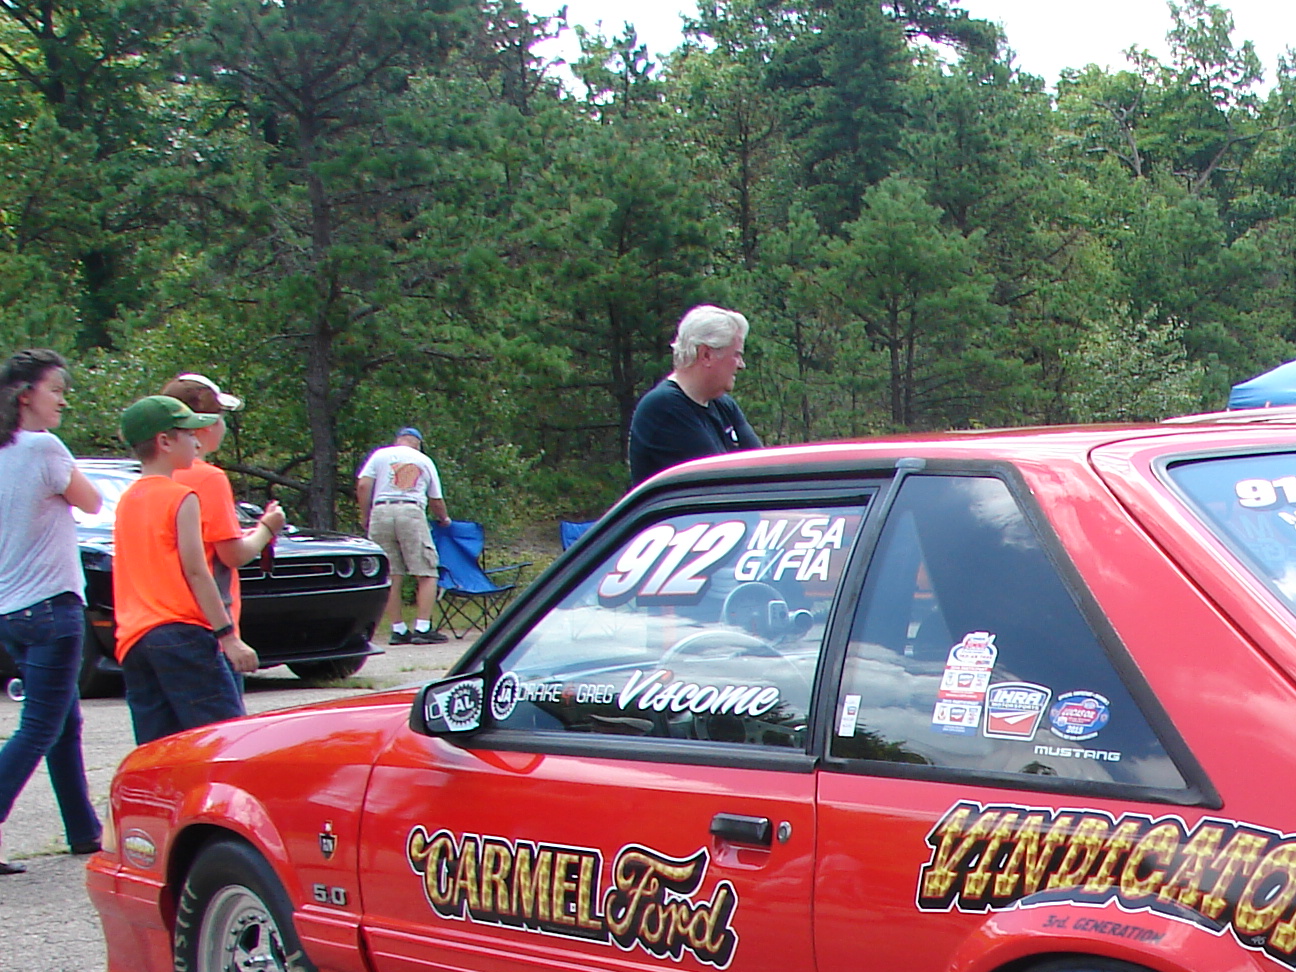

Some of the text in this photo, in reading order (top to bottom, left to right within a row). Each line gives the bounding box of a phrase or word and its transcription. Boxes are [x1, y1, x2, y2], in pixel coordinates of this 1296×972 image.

[748, 517, 847, 550] M/SA
[599, 519, 746, 605] 912
[734, 548, 832, 582] G/FIA
[518, 683, 563, 702] DRAKE
[576, 684, 615, 704] GREG
[618, 669, 780, 717] Viscome
[992, 690, 1043, 706] IHRA
[1034, 745, 1121, 762] MUSTANG
[313, 883, 348, 906] 5.0
[408, 827, 734, 964] CARMEL Ford
[1072, 917, 1167, 944] GENERATION
